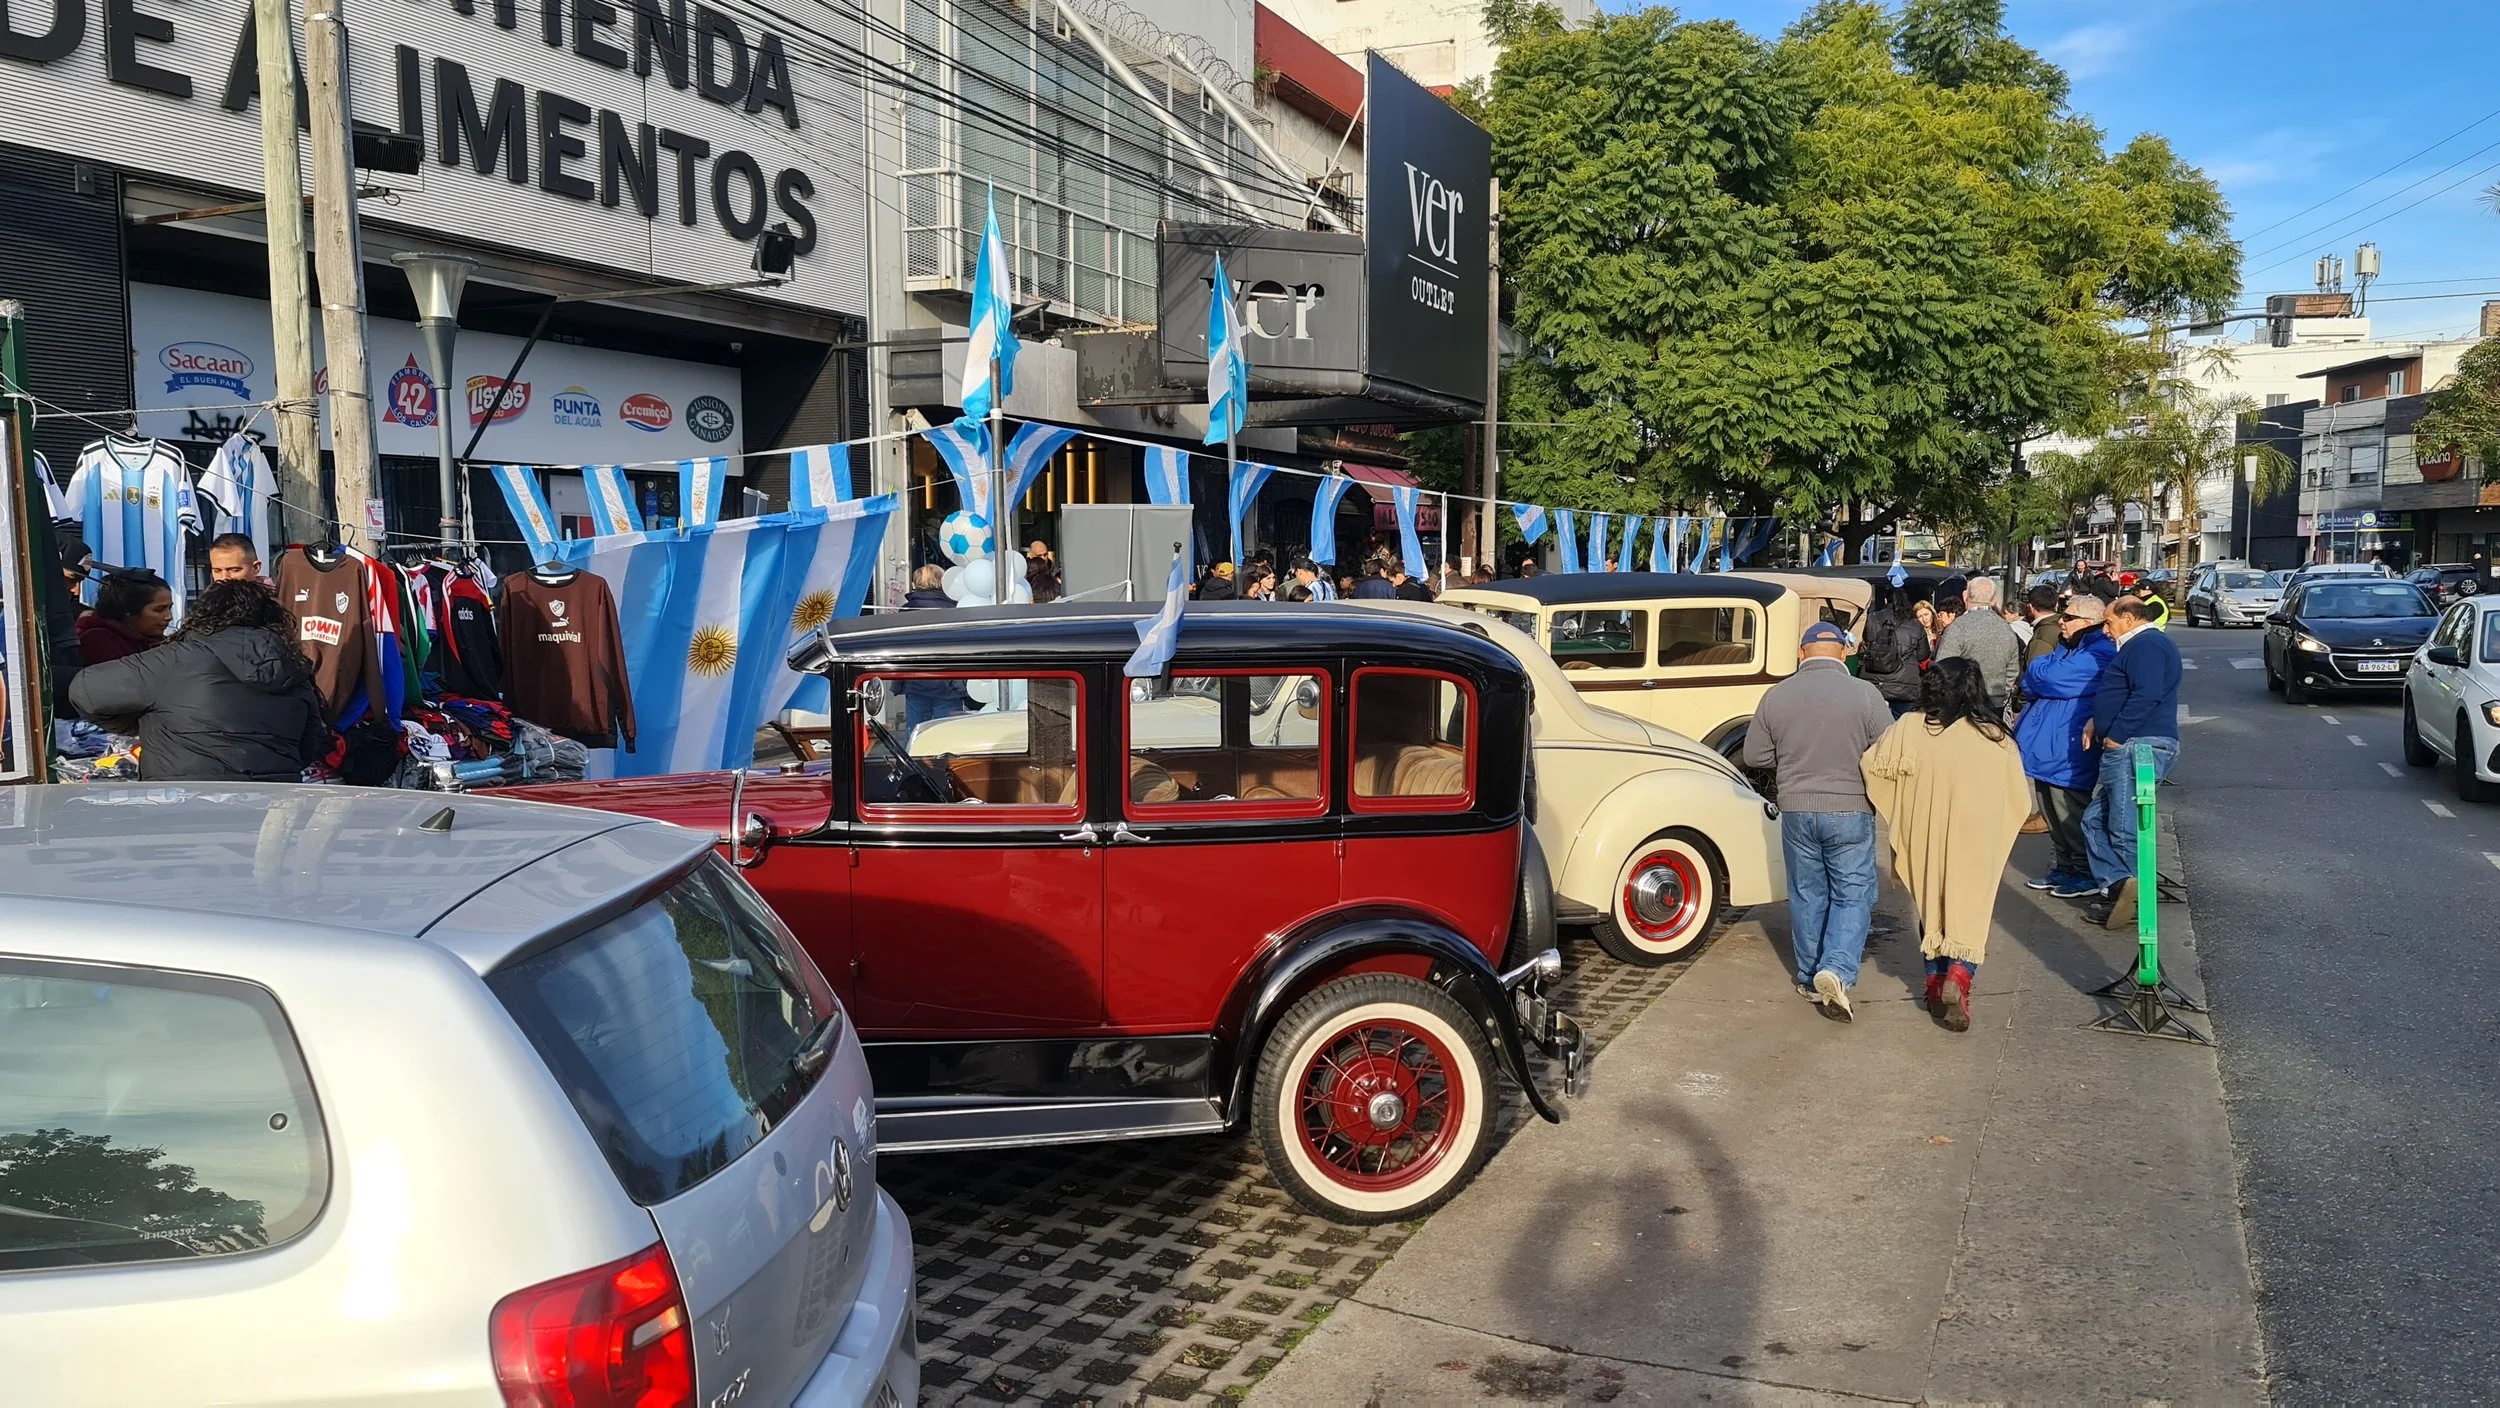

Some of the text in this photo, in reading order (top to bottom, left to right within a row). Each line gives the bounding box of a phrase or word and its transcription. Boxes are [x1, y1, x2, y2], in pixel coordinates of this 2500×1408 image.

[221, 0, 818, 256] AIMENTOS
[1411, 276, 1455, 315] OUTLET
[168, 348, 244, 374] Sacaan
[180, 376, 237, 389] EL BUEN PAN
[397, 382, 428, 416] 42
[553, 398, 602, 417] PUNTA
[694, 398, 726, 413] UNION
[393, 407, 436, 427] LOS CALVOS
[554, 415, 602, 428] DEL AGUA
[689, 418, 733, 441] GANADERA
